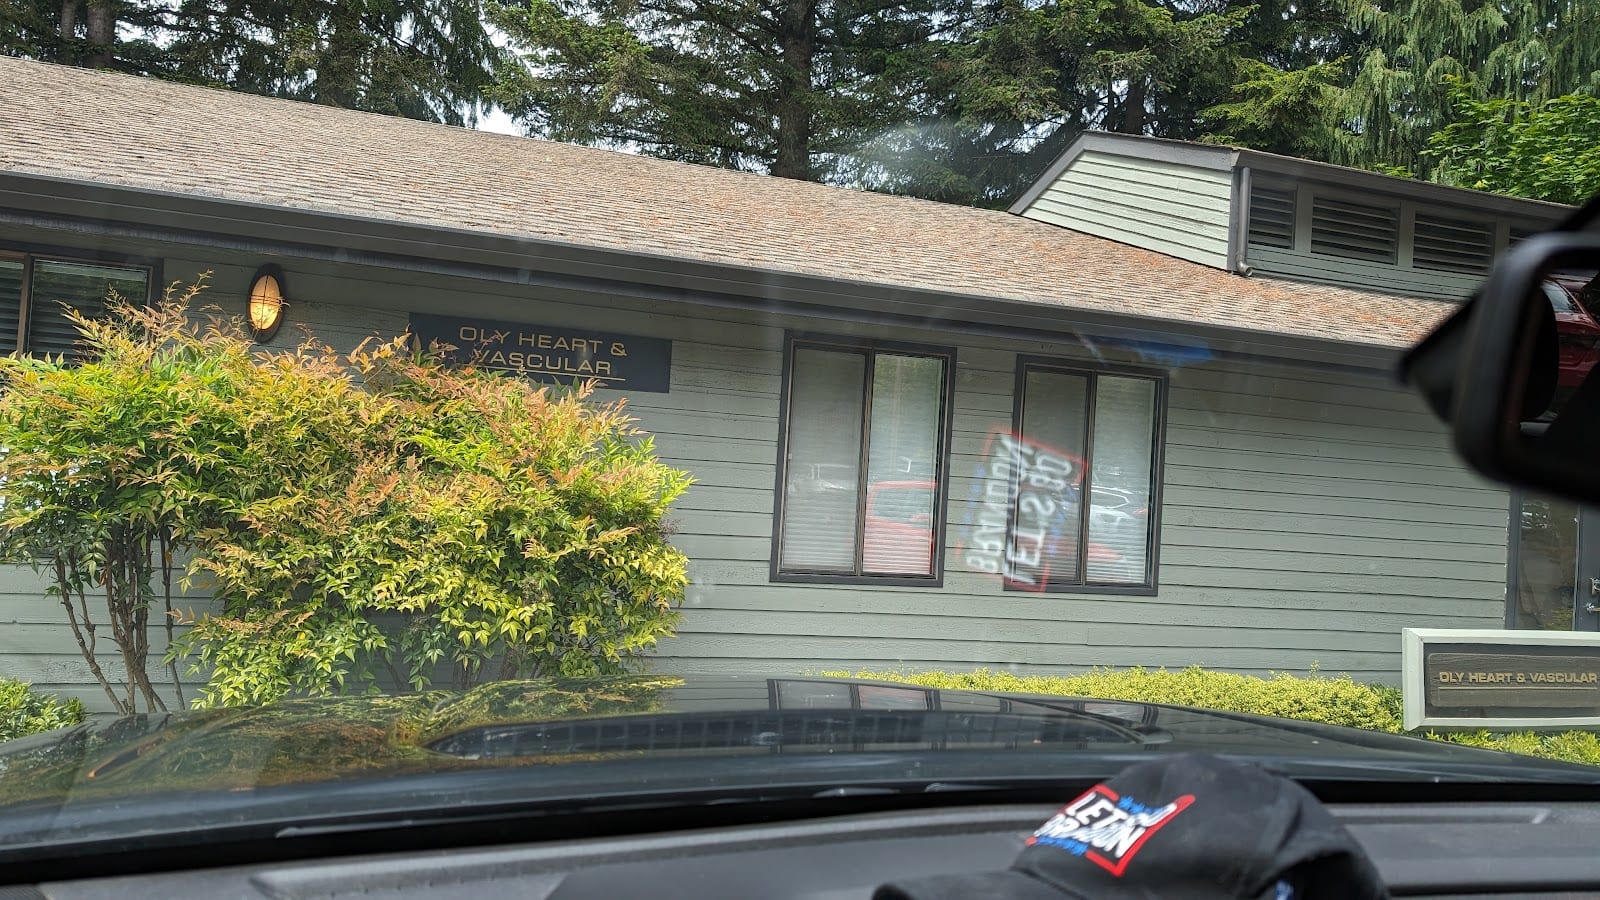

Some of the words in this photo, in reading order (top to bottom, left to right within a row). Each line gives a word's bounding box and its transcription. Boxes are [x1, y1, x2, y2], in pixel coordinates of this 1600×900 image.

[458, 326, 511, 345] OLY
[518, 332, 603, 354] HEART
[610, 342, 627, 357] &
[473, 348, 611, 375] VASCULAR
[1439, 671, 1465, 683] OLY
[1468, 671, 1513, 683] HEART
[1516, 672, 1526, 683] &
[1529, 672, 1598, 683] VASCULAR
